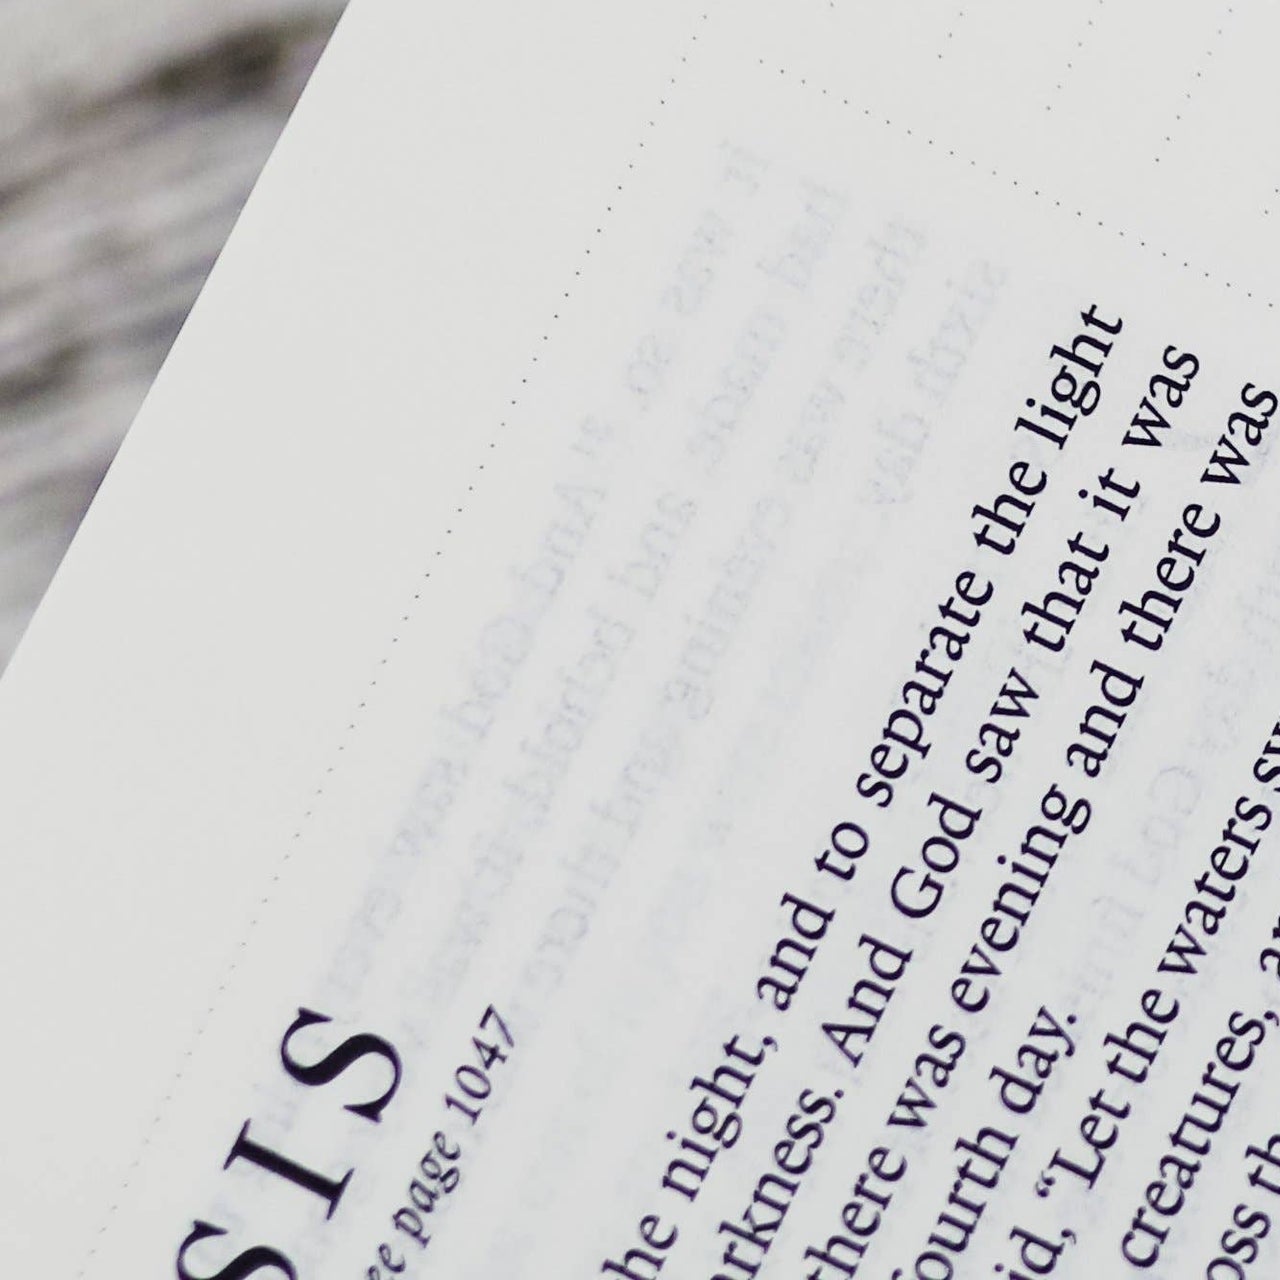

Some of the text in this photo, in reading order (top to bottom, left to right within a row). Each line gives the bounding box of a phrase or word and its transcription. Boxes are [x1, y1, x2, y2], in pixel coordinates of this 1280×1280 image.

[661, 1033, 778, 1203] night,
[755, 891, 836, 1013] and
[813, 821, 870, 882] to
[855, 570, 995, 809] separate
[970, 460, 1049, 557] the
[1013, 303, 1124, 451] light
[709, 344, 1201, 1280] rkness. And God saw that it was
[885, 1023, 967, 1129] was
[950, 782, 1093, 1014] evening
[1065, 658, 1146, 779] and
[1117, 502, 1222, 652] there
[1198, 381, 1279, 486] was
[391, 1130, 462, 1249] page
[444, 1004, 515, 1126] 1047
[890, 1005, 1078, 1280] ourth day.
[1034, 1088, 1132, 1199] “Let
[1102, 988, 1181, 1085] the
[1156, 795, 1273, 976] waters
[1121, 1009, 1280, 1270] creatures,
